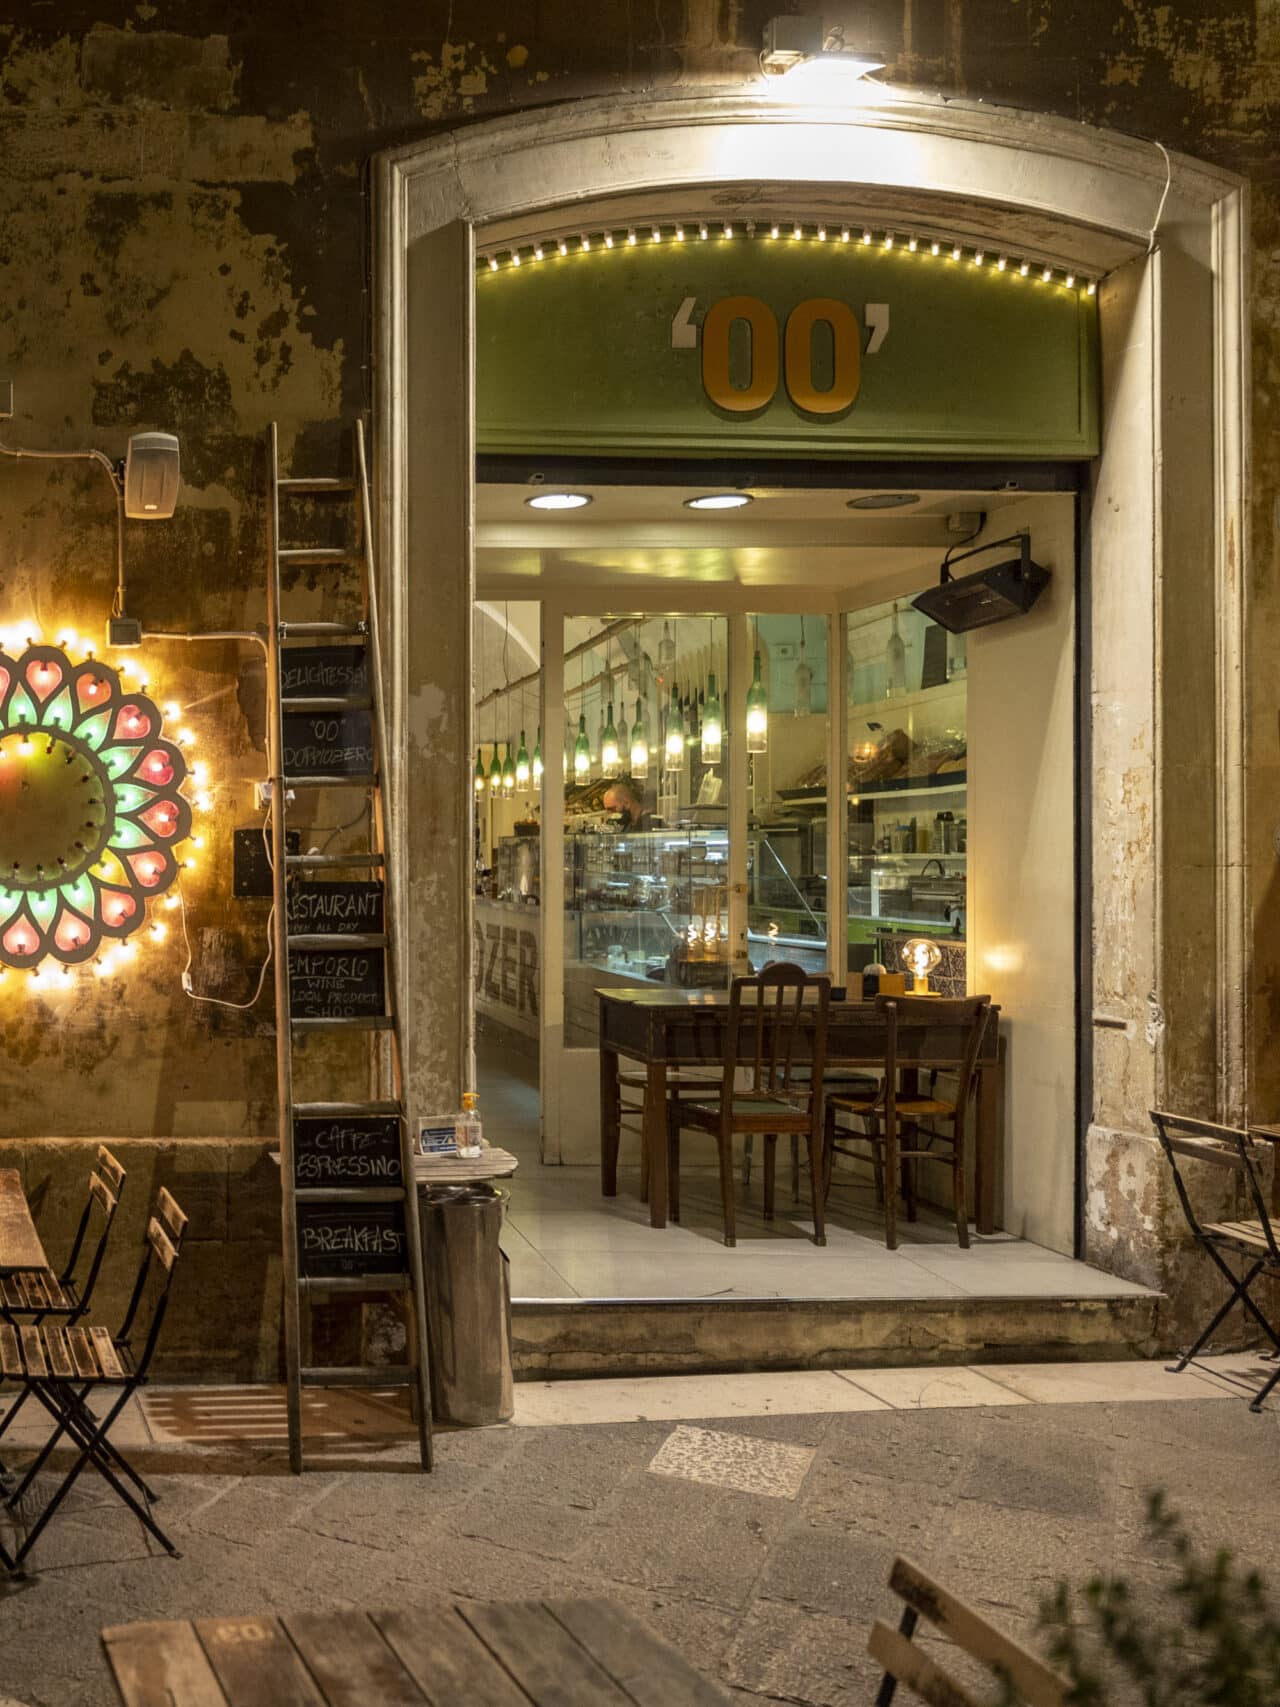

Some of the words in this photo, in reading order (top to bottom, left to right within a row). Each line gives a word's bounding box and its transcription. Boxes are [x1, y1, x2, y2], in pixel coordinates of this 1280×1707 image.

[337, 921, 359, 932] DAY
[288, 955, 369, 977] EMPORIO
[307, 978, 345, 989] WINE
[304, 1005, 354, 1017] SHOP
[297, 1153, 401, 1178] ESPRESSINO
[303, 1225, 404, 1254] BREAKFAST
